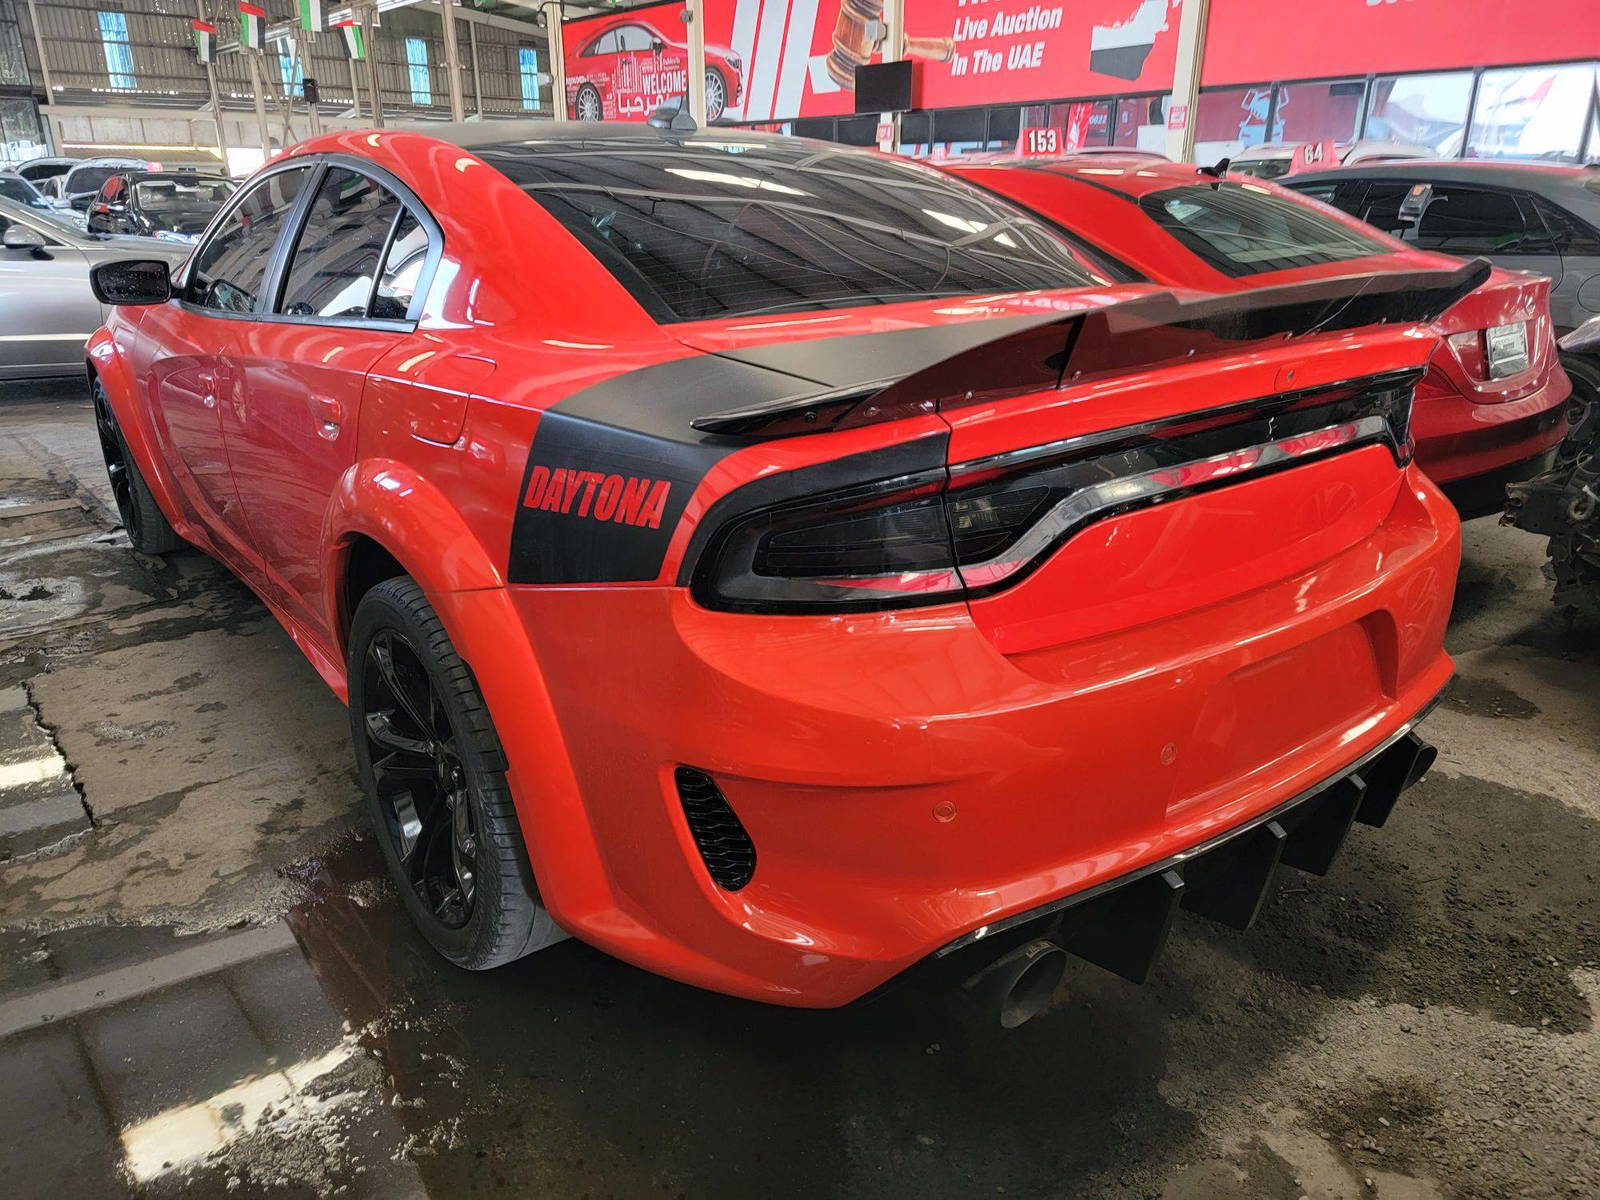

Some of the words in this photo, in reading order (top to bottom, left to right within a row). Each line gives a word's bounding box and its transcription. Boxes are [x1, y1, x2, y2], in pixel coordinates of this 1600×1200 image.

[953, 16, 989, 42] Live
[990, 5, 1064, 37] Auction
[951, 52, 969, 76] In
[972, 48, 1003, 74] The
[1007, 41, 1046, 70] UAE
[642, 70, 687, 95] WELCOME
[1028, 129, 1057, 153] 153
[522, 465, 671, 529] DAYTONA
